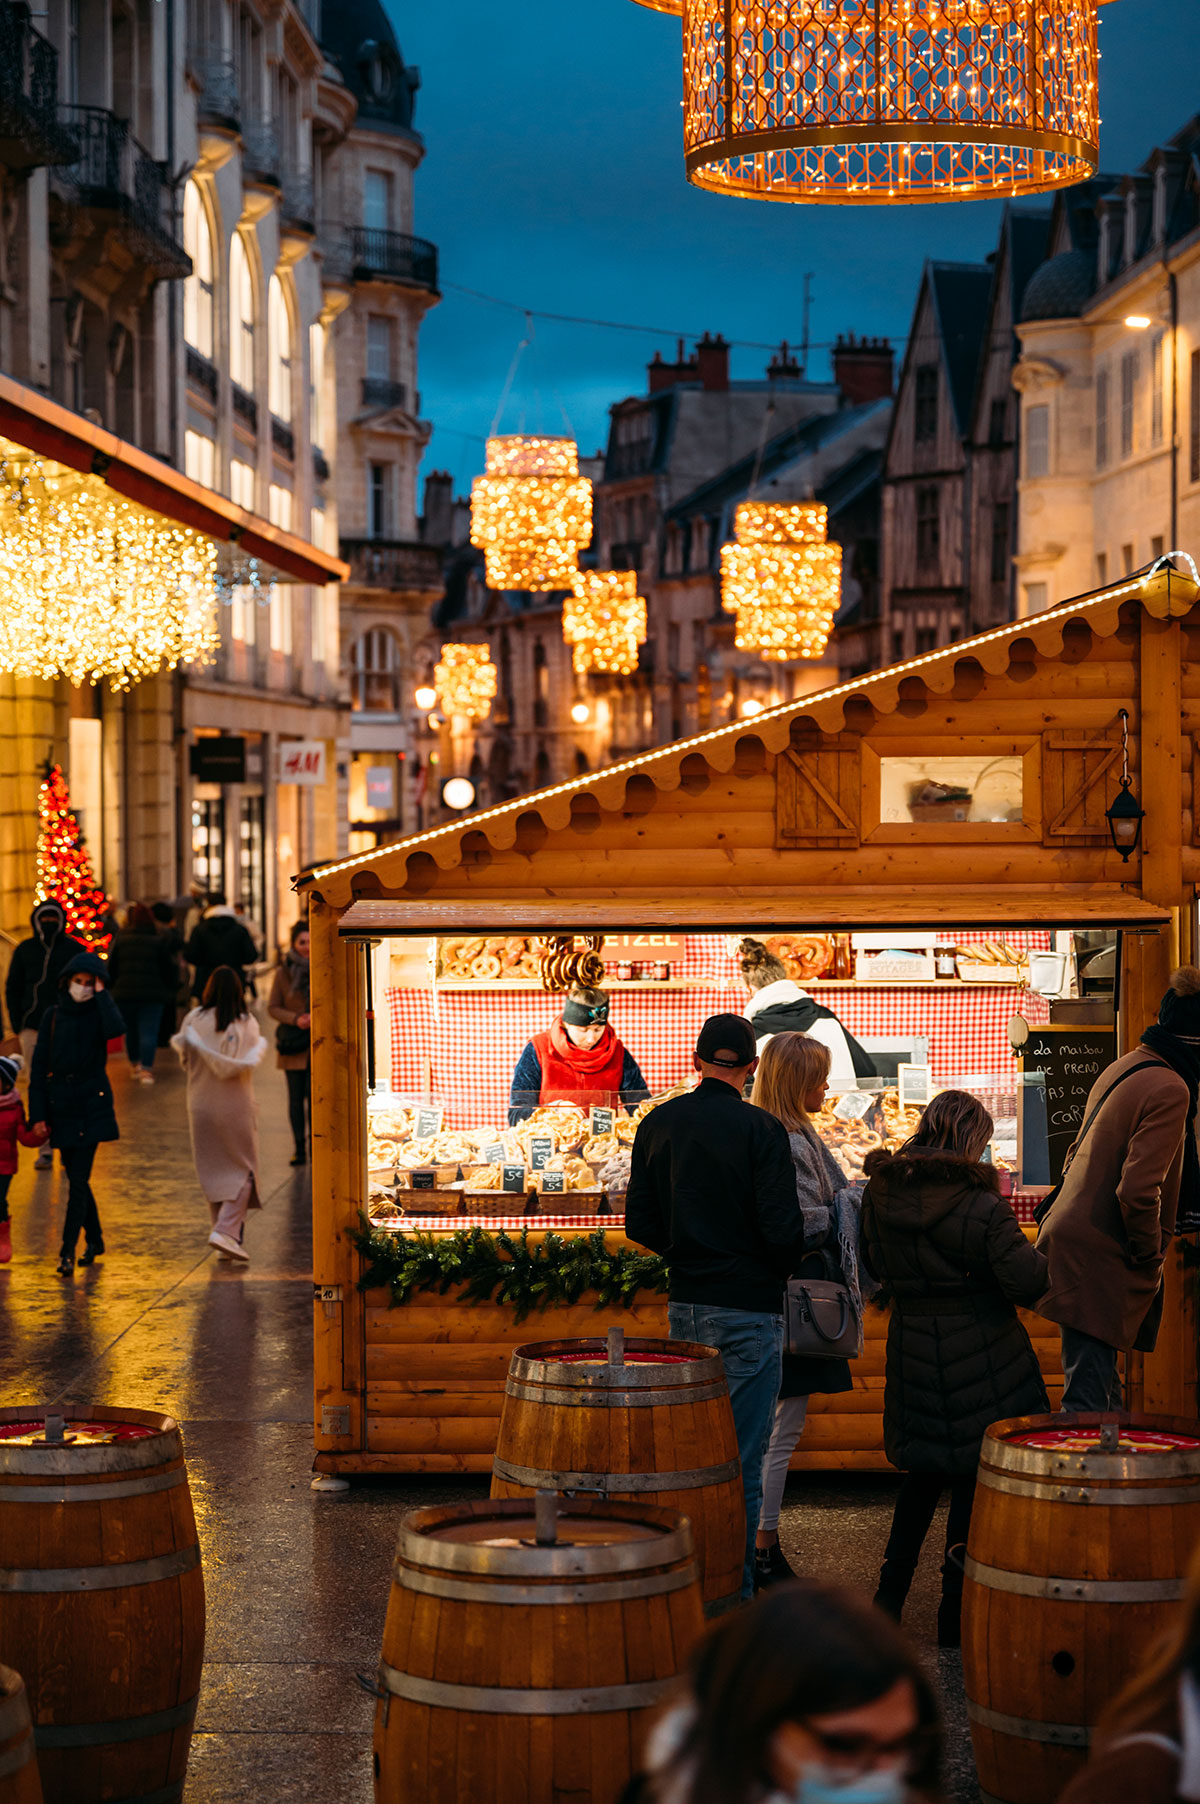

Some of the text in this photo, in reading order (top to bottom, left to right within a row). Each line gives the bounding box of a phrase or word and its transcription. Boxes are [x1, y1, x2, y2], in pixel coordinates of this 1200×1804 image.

[284, 752, 321, 776] H&M
[504, 1170, 523, 1182] 5€
[322, 1290, 334, 1300] 10
